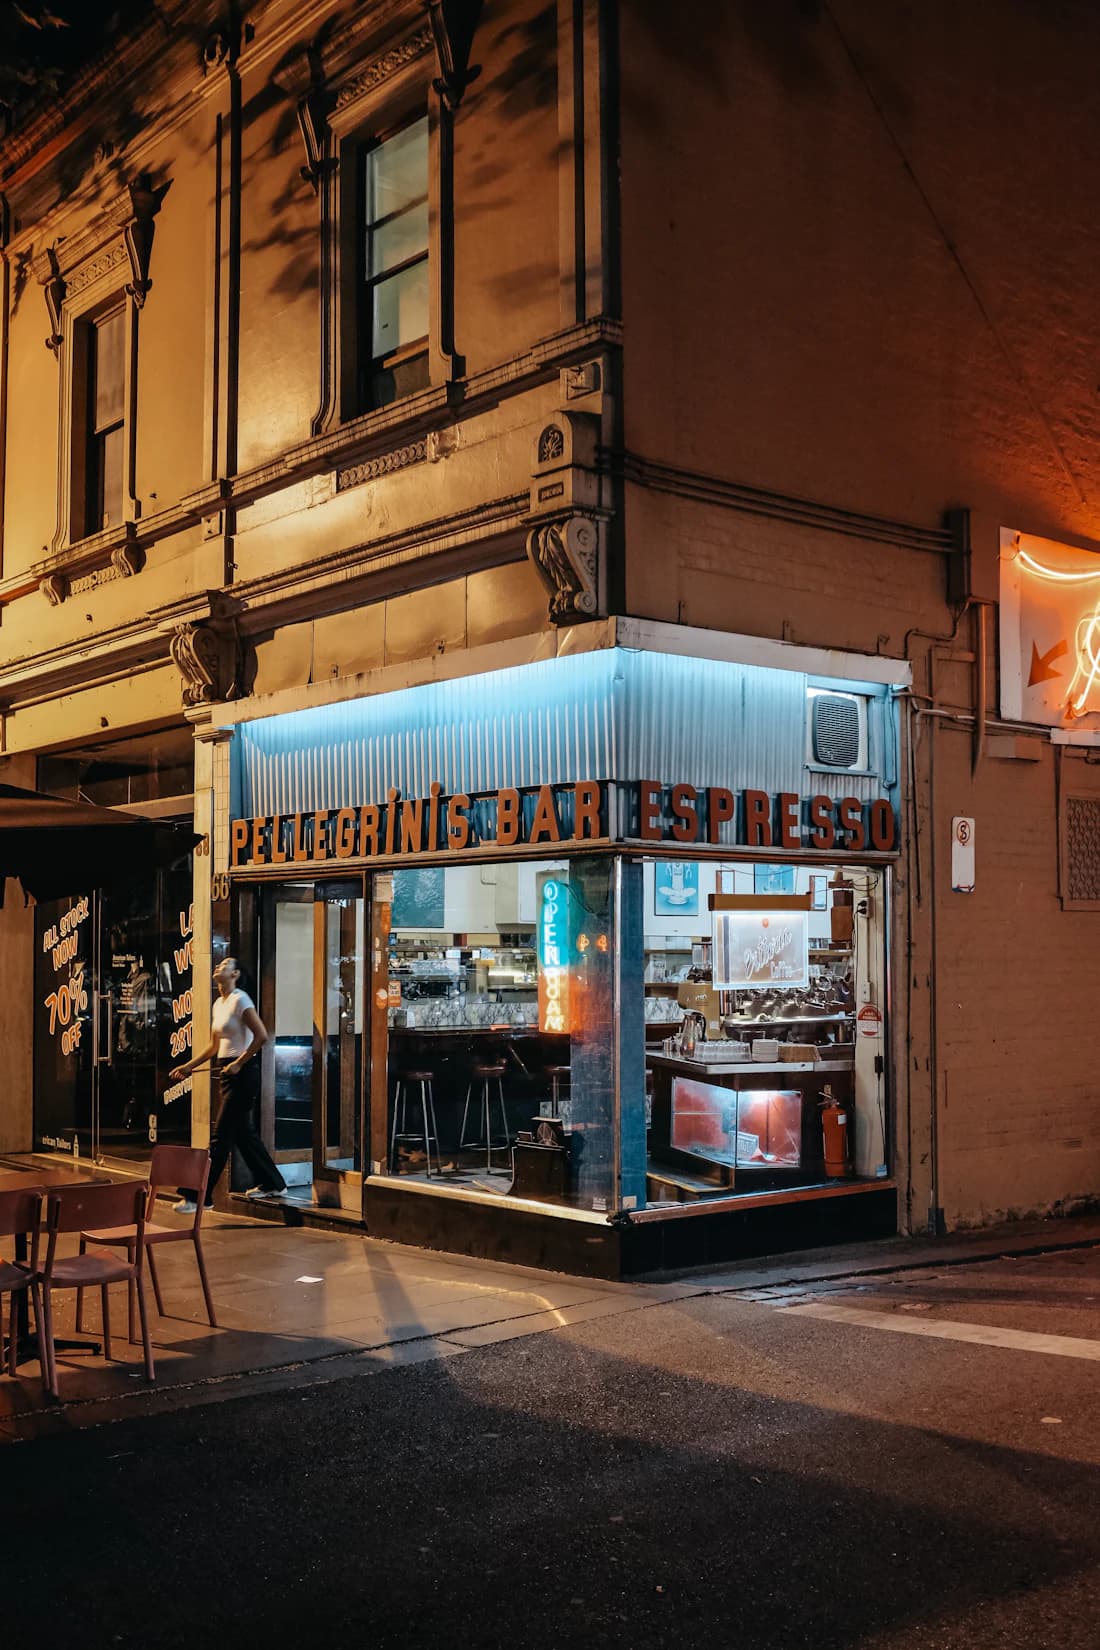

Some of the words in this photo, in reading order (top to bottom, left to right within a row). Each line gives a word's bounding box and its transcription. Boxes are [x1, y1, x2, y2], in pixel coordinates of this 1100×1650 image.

[496, 780, 600, 846] BAR
[640, 780, 895, 850] ESPRESSO
[211, 873, 229, 901] 66
[43, 925, 59, 953] ALL
[60, 896, 89, 937] STOCK
[52, 930, 78, 971] NOW
[544, 881, 560, 967] OPEN
[44, 971, 88, 1035] 70%
[61, 1021, 82, 1056] OFF
